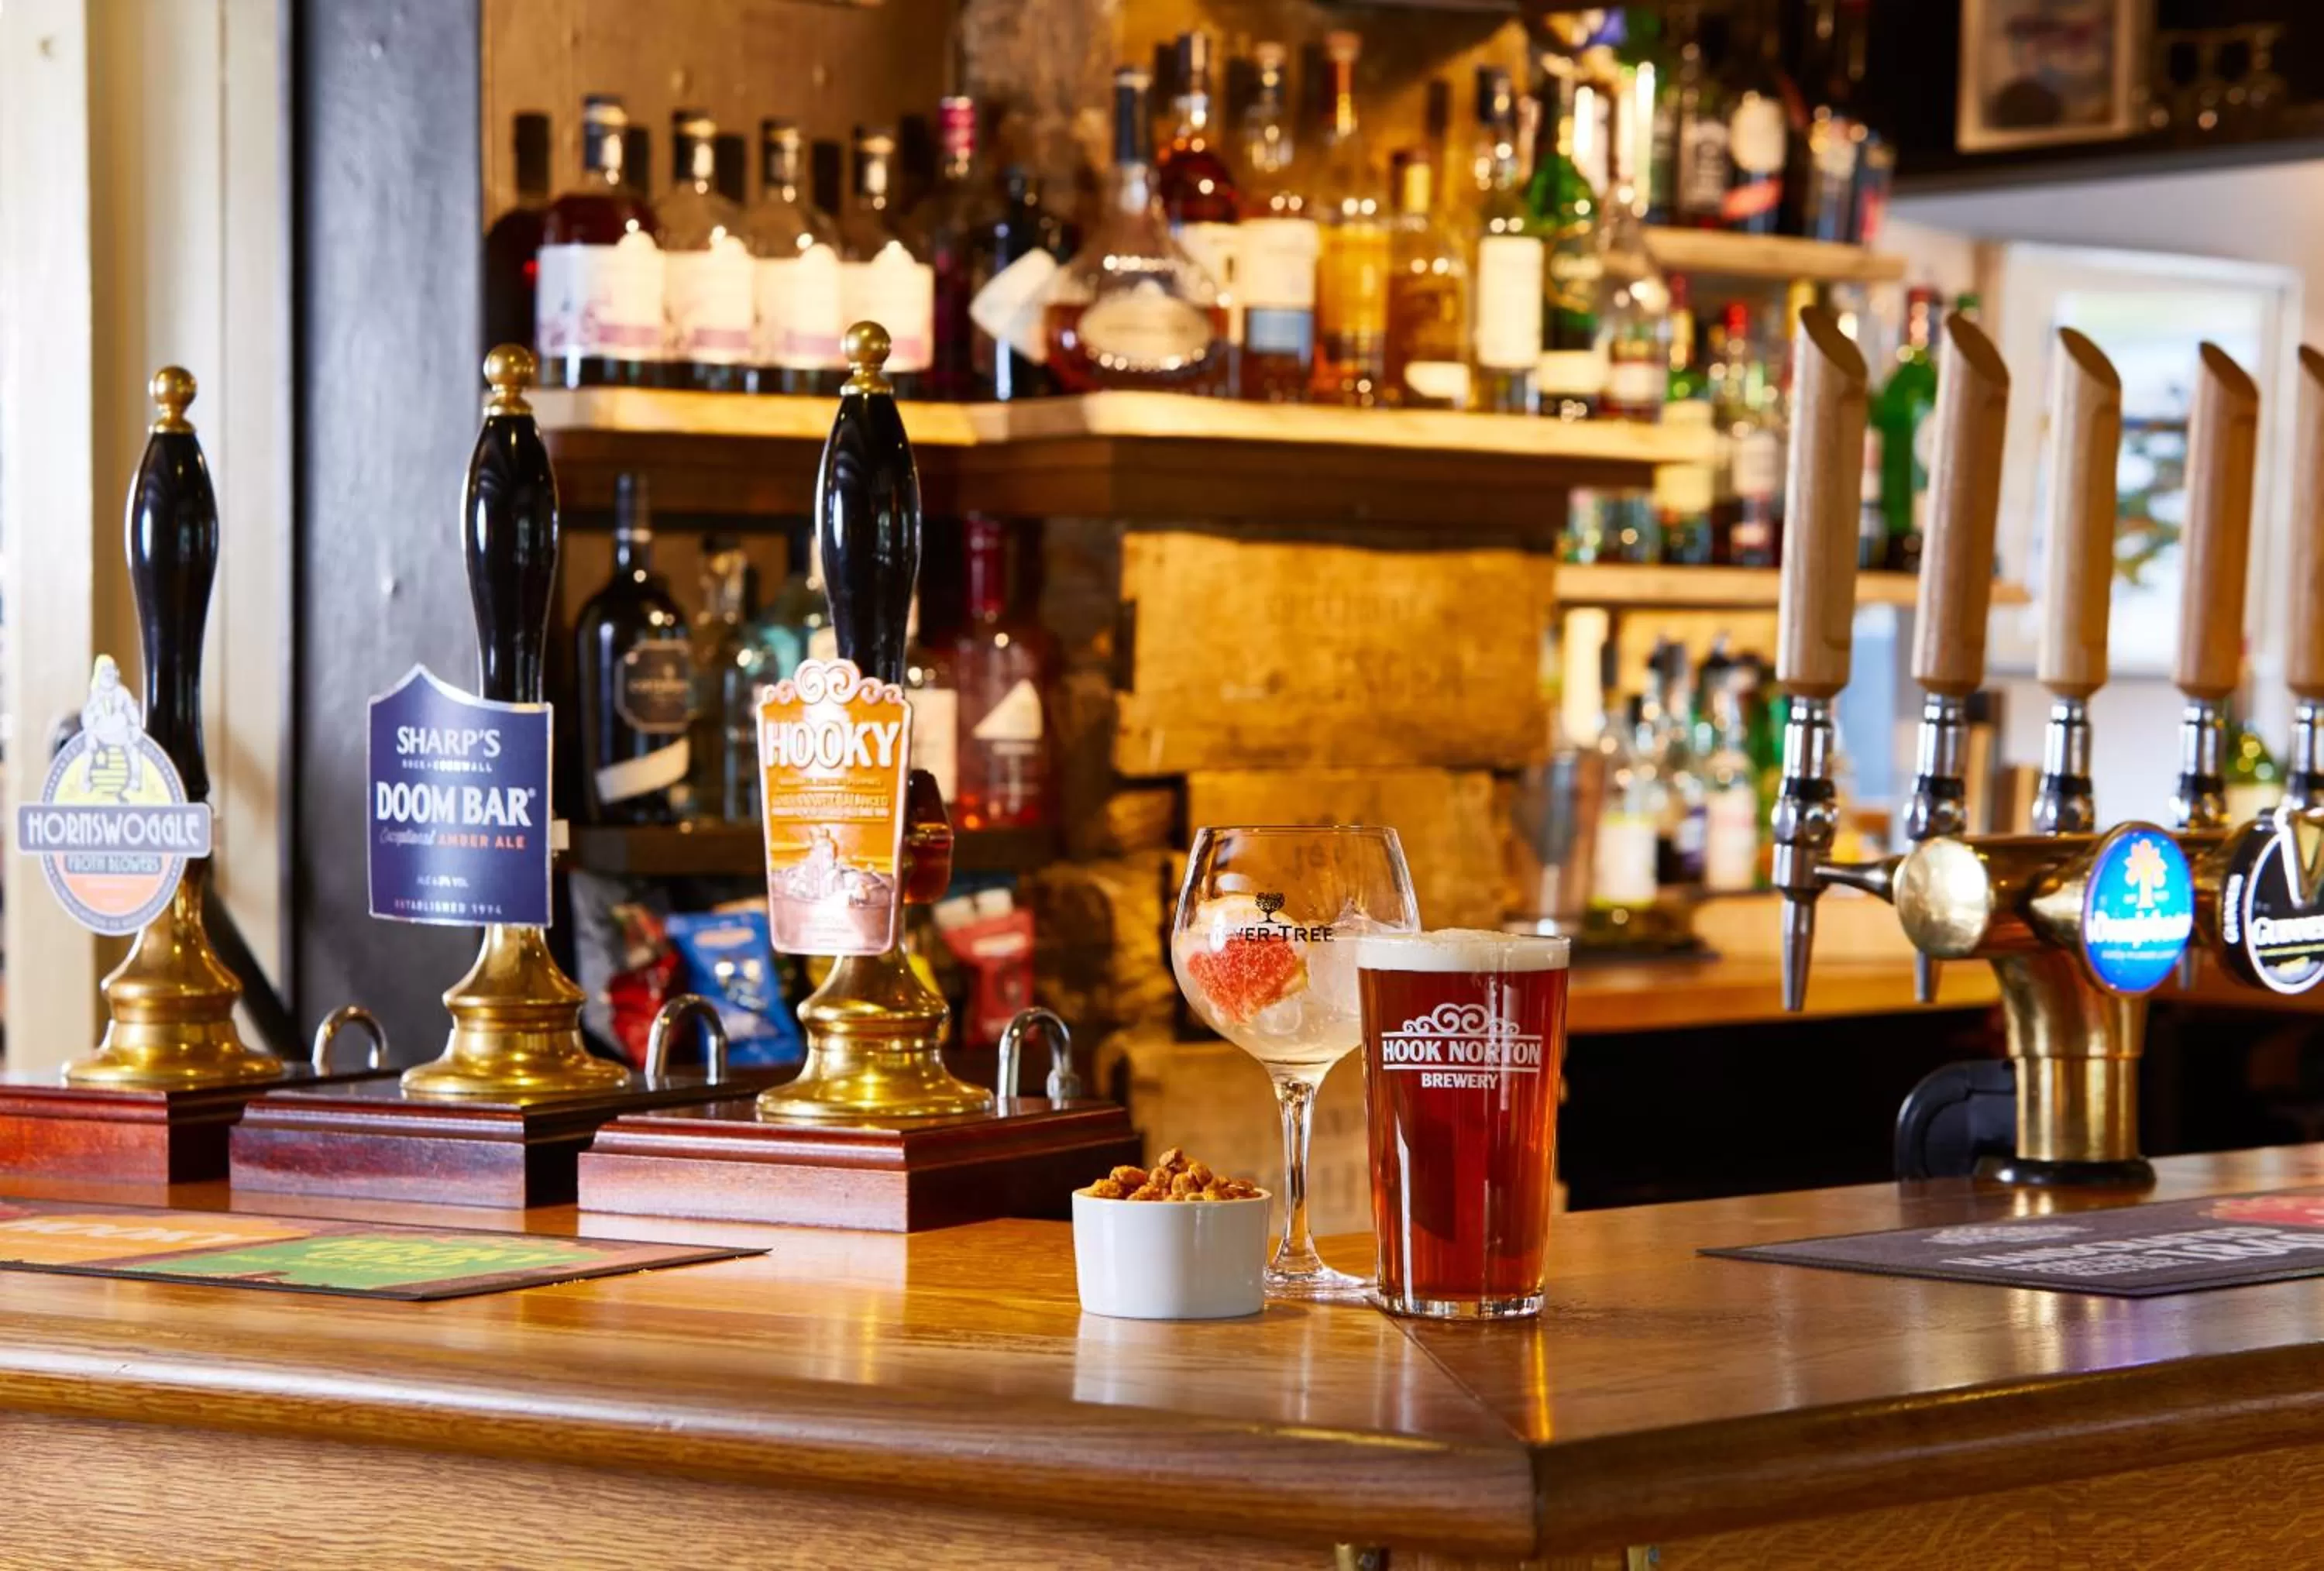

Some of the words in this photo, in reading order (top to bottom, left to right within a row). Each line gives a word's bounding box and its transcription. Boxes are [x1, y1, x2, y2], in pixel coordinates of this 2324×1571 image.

[396, 726, 501, 758] SHARP'S
[765, 721, 902, 768] HOOKY
[376, 781, 455, 825] DOOM
[27, 812, 201, 847] HORNSWOGGLE
[495, 834, 525, 850] ALE
[1382, 1039, 1442, 1063] HOOK
[1448, 1040, 1542, 1065] NORTON
[1421, 1072, 1499, 1090] BREWERY
